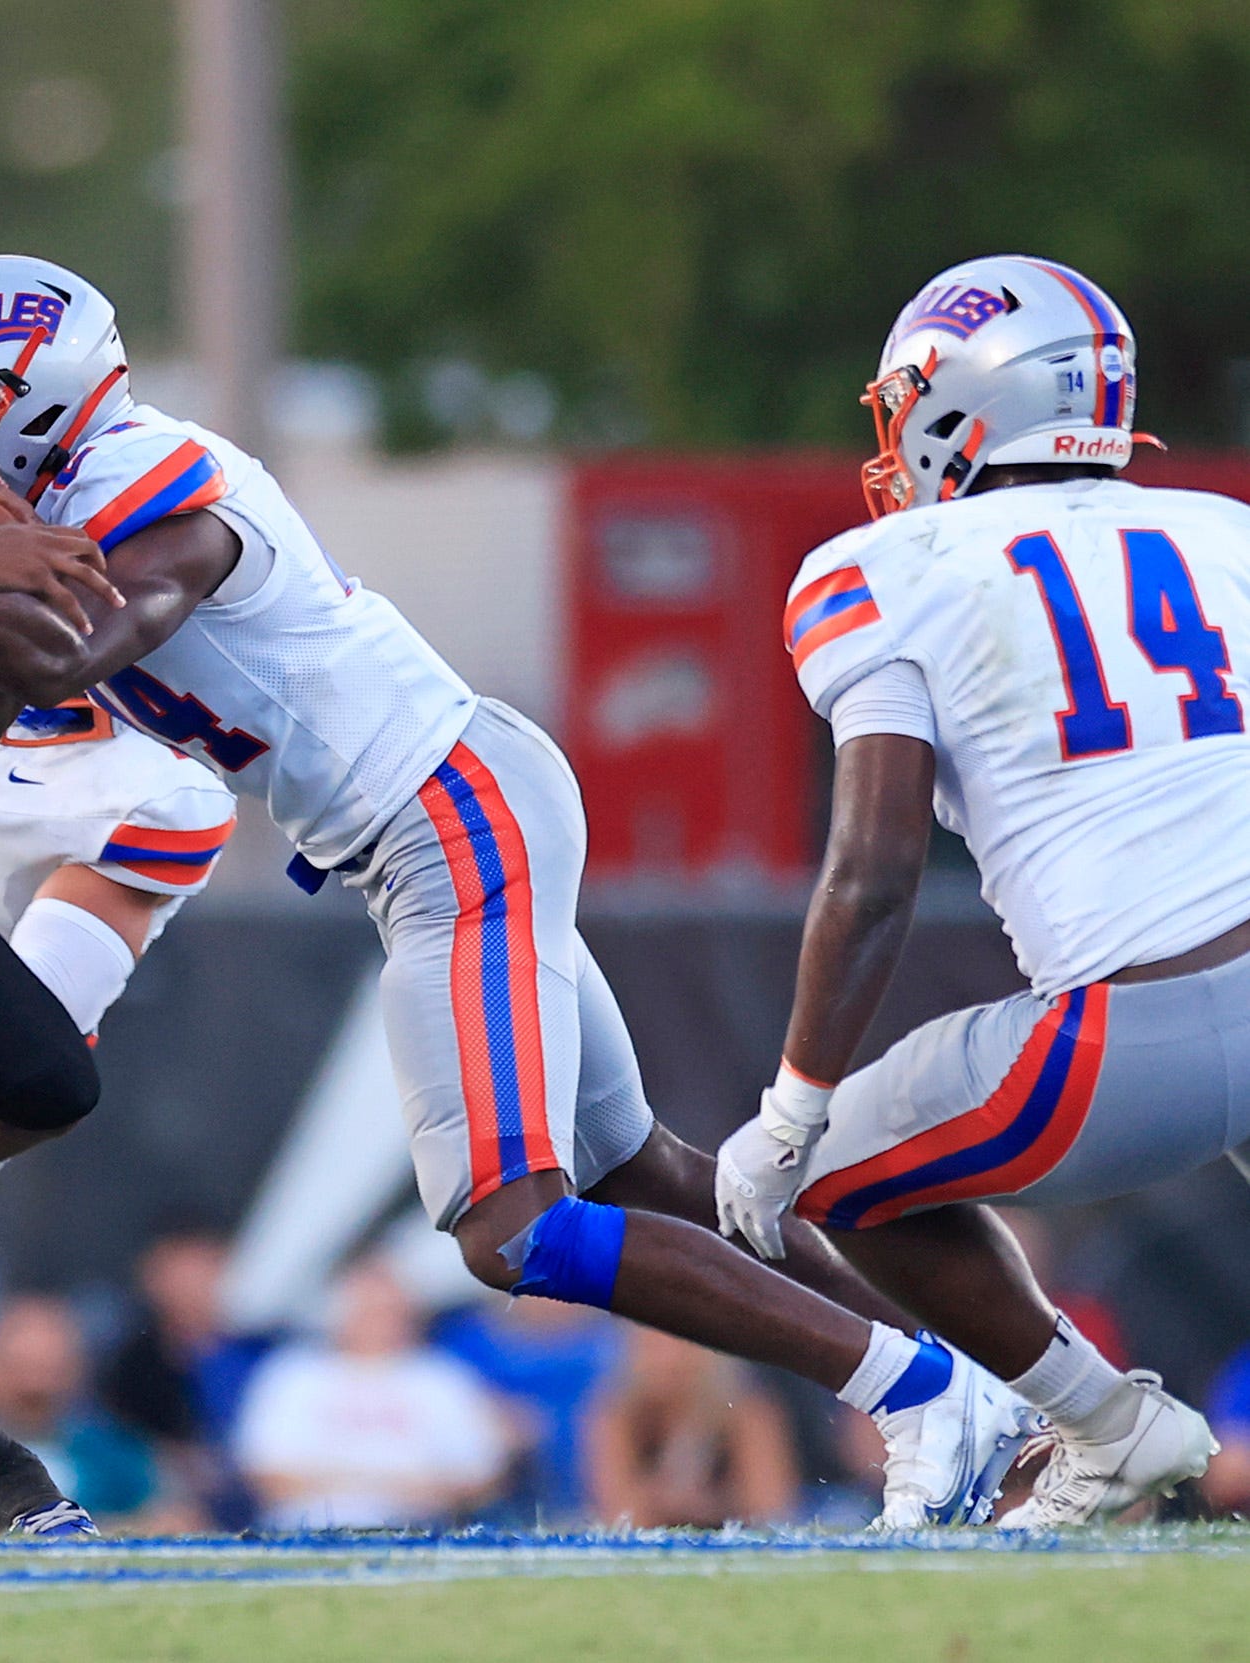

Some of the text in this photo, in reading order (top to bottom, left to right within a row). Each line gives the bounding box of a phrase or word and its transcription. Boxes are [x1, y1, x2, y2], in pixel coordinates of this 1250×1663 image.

[912, 284, 1011, 334] LLES
[1067, 371, 1084, 393] 14
[1002, 528, 1246, 763] 14
[84, 663, 271, 774] 4
